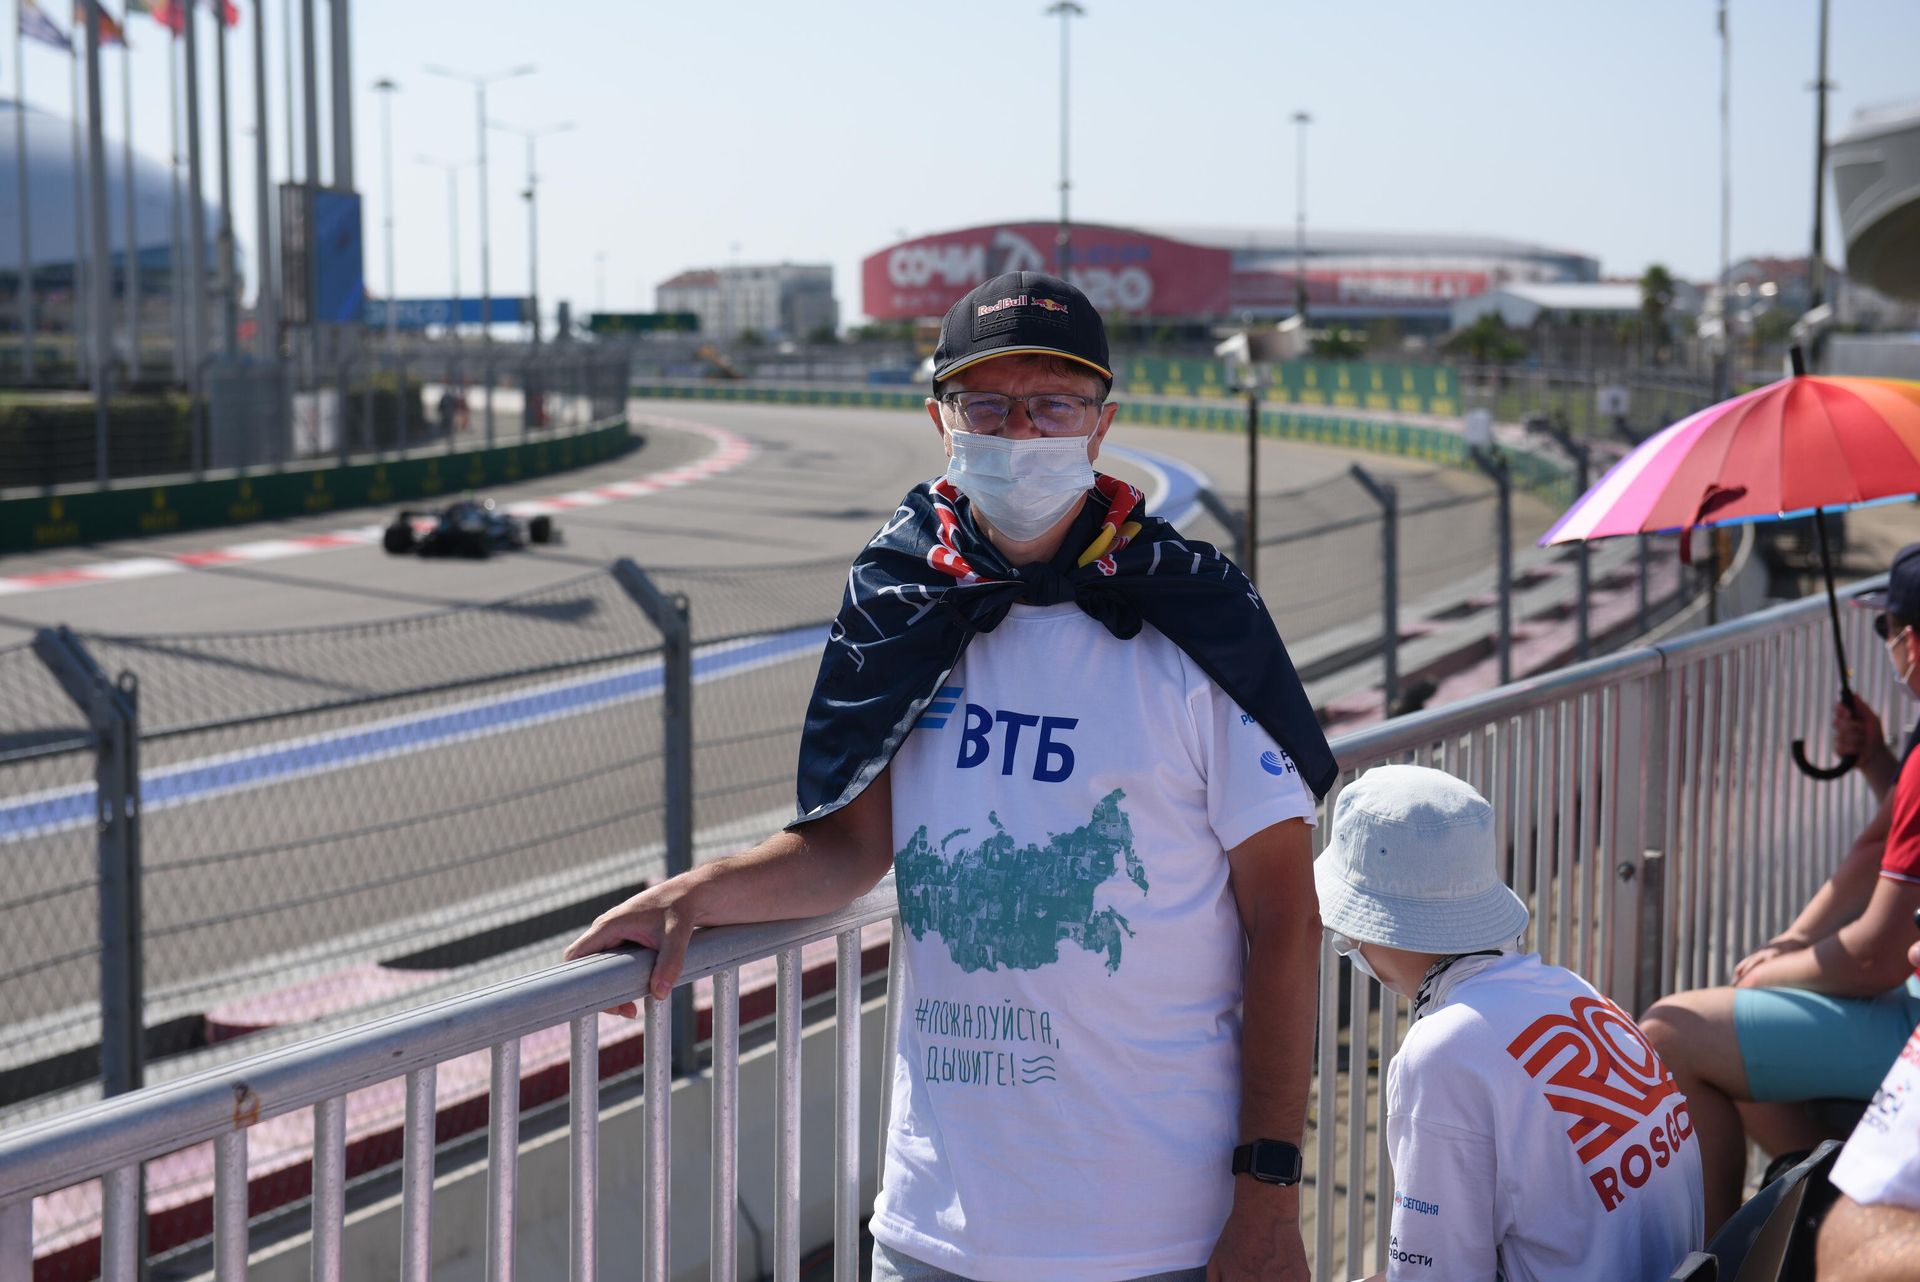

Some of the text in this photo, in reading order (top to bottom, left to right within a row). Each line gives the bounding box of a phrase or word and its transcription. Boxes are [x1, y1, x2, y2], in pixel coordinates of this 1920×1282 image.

[956, 703, 1079, 783] ВТБ
[915, 998, 1060, 1049] #ПОЖАЛУЙСТА,
[925, 1045, 1015, 1086] ДЫШИТЕ!
[1589, 1101, 1694, 1213] ROSGO
[1402, 1196, 1439, 1216] СЕГОДНЯ
